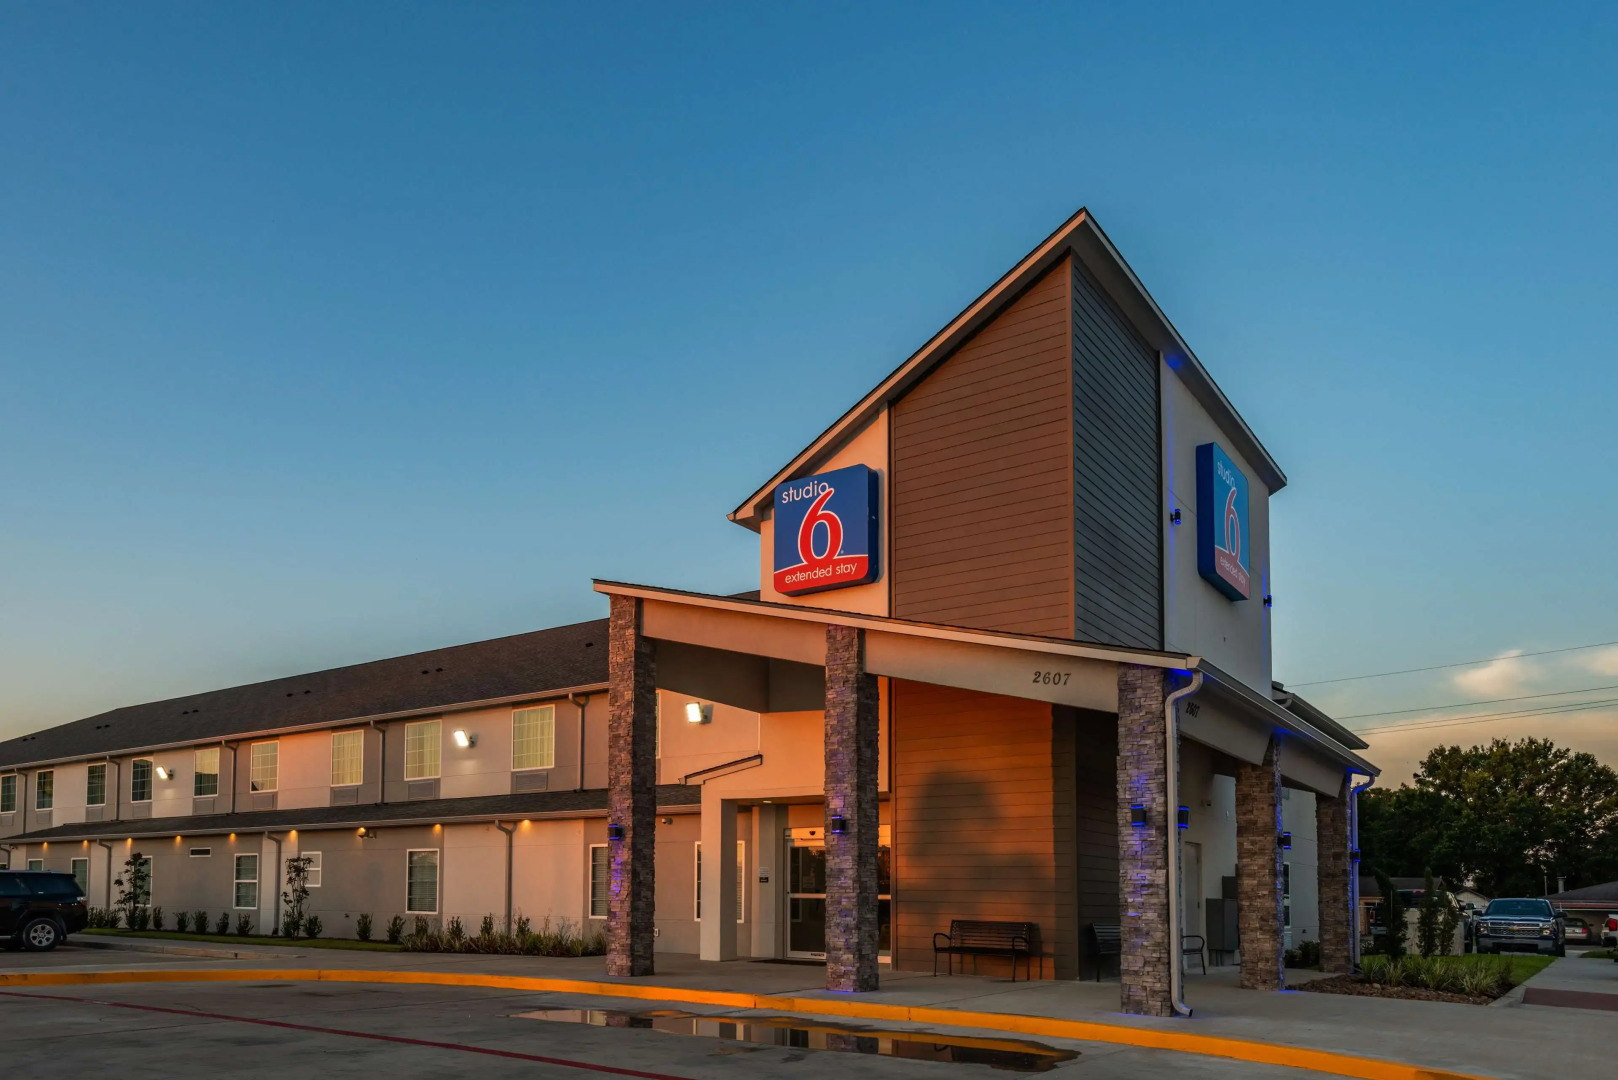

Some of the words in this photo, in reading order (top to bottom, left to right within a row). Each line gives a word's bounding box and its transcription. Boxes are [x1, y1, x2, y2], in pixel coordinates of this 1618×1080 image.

[1217, 460, 1235, 489] studio
[782, 480, 829, 503] studio
[798, 488, 844, 564] 6
[1225, 487, 1241, 562] 6
[785, 565, 833, 584] extended
[836, 562, 858, 575] stay
[1032, 670, 1072, 686] 2607
[1185, 701, 1200, 718] 2607
